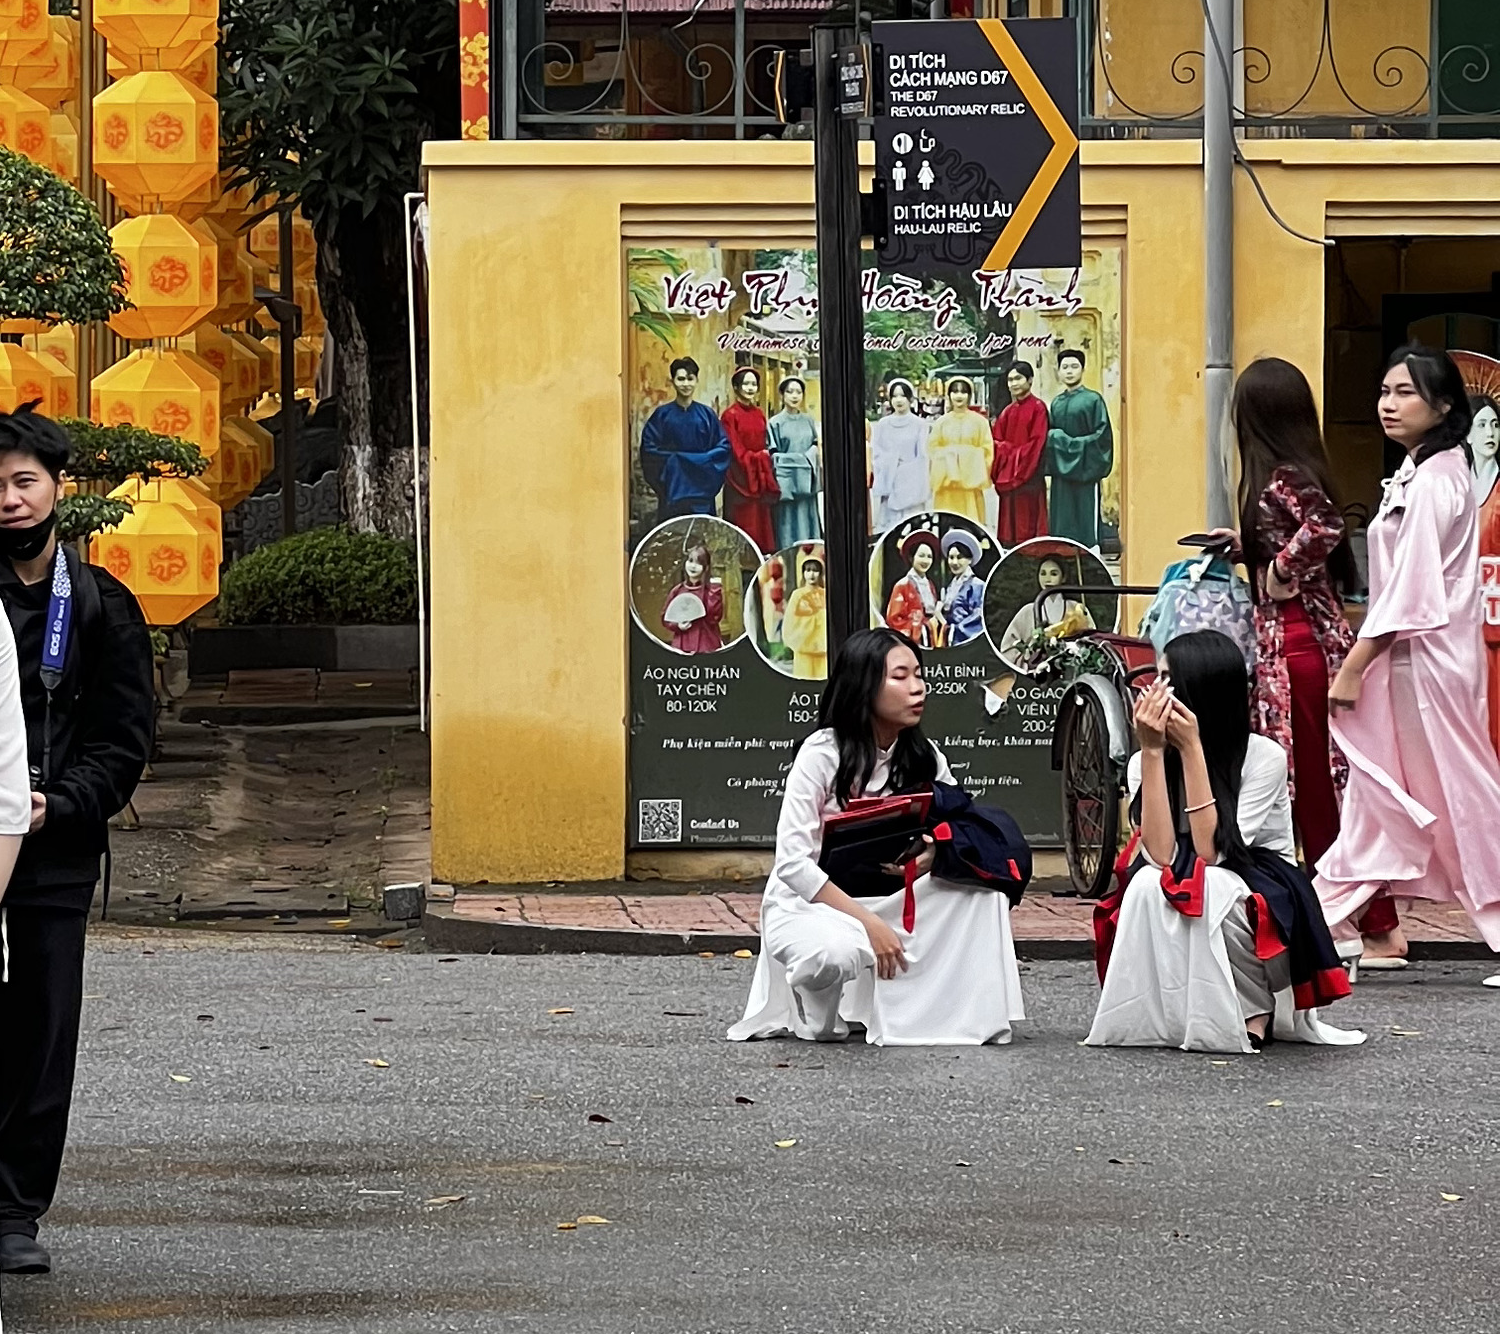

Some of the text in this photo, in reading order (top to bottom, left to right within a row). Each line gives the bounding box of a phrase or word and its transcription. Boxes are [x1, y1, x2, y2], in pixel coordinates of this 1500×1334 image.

[889, 52, 946, 69] DI TÍCH
[889, 70, 1009, 89] CÁCH MẠNG D67
[890, 90, 938, 102] THE D67
[890, 103, 1026, 117] REVOLUTIONARY RELIC
[894, 205, 912, 220] DI
[912, 202, 946, 219] TÍCH
[949, 202, 980, 221] HẬU
[894, 222, 982, 235] HAU-LAU RELIC
[663, 271, 733, 316] Việt
[744, 270, 818, 316] Phụ
[975, 268, 1082, 316] Thành
[717, 331, 807, 351] Vietnamese
[906, 334, 976, 351] costumes
[981, 332, 1013, 354] for
[1017, 333, 1053, 348] rent
[49, 633, 61, 656] EOS
[643, 664, 665, 680] ÁO
[924, 663, 986, 681] HẬT BÌNH
[656, 683, 683, 696] TAY
[666, 700, 718, 713] 80-120K
[788, 691, 811, 707] ÁO
[788, 710, 819, 723] 150-2
[1022, 719, 1056, 733] 200-2
[690, 818, 726, 829] Contact
